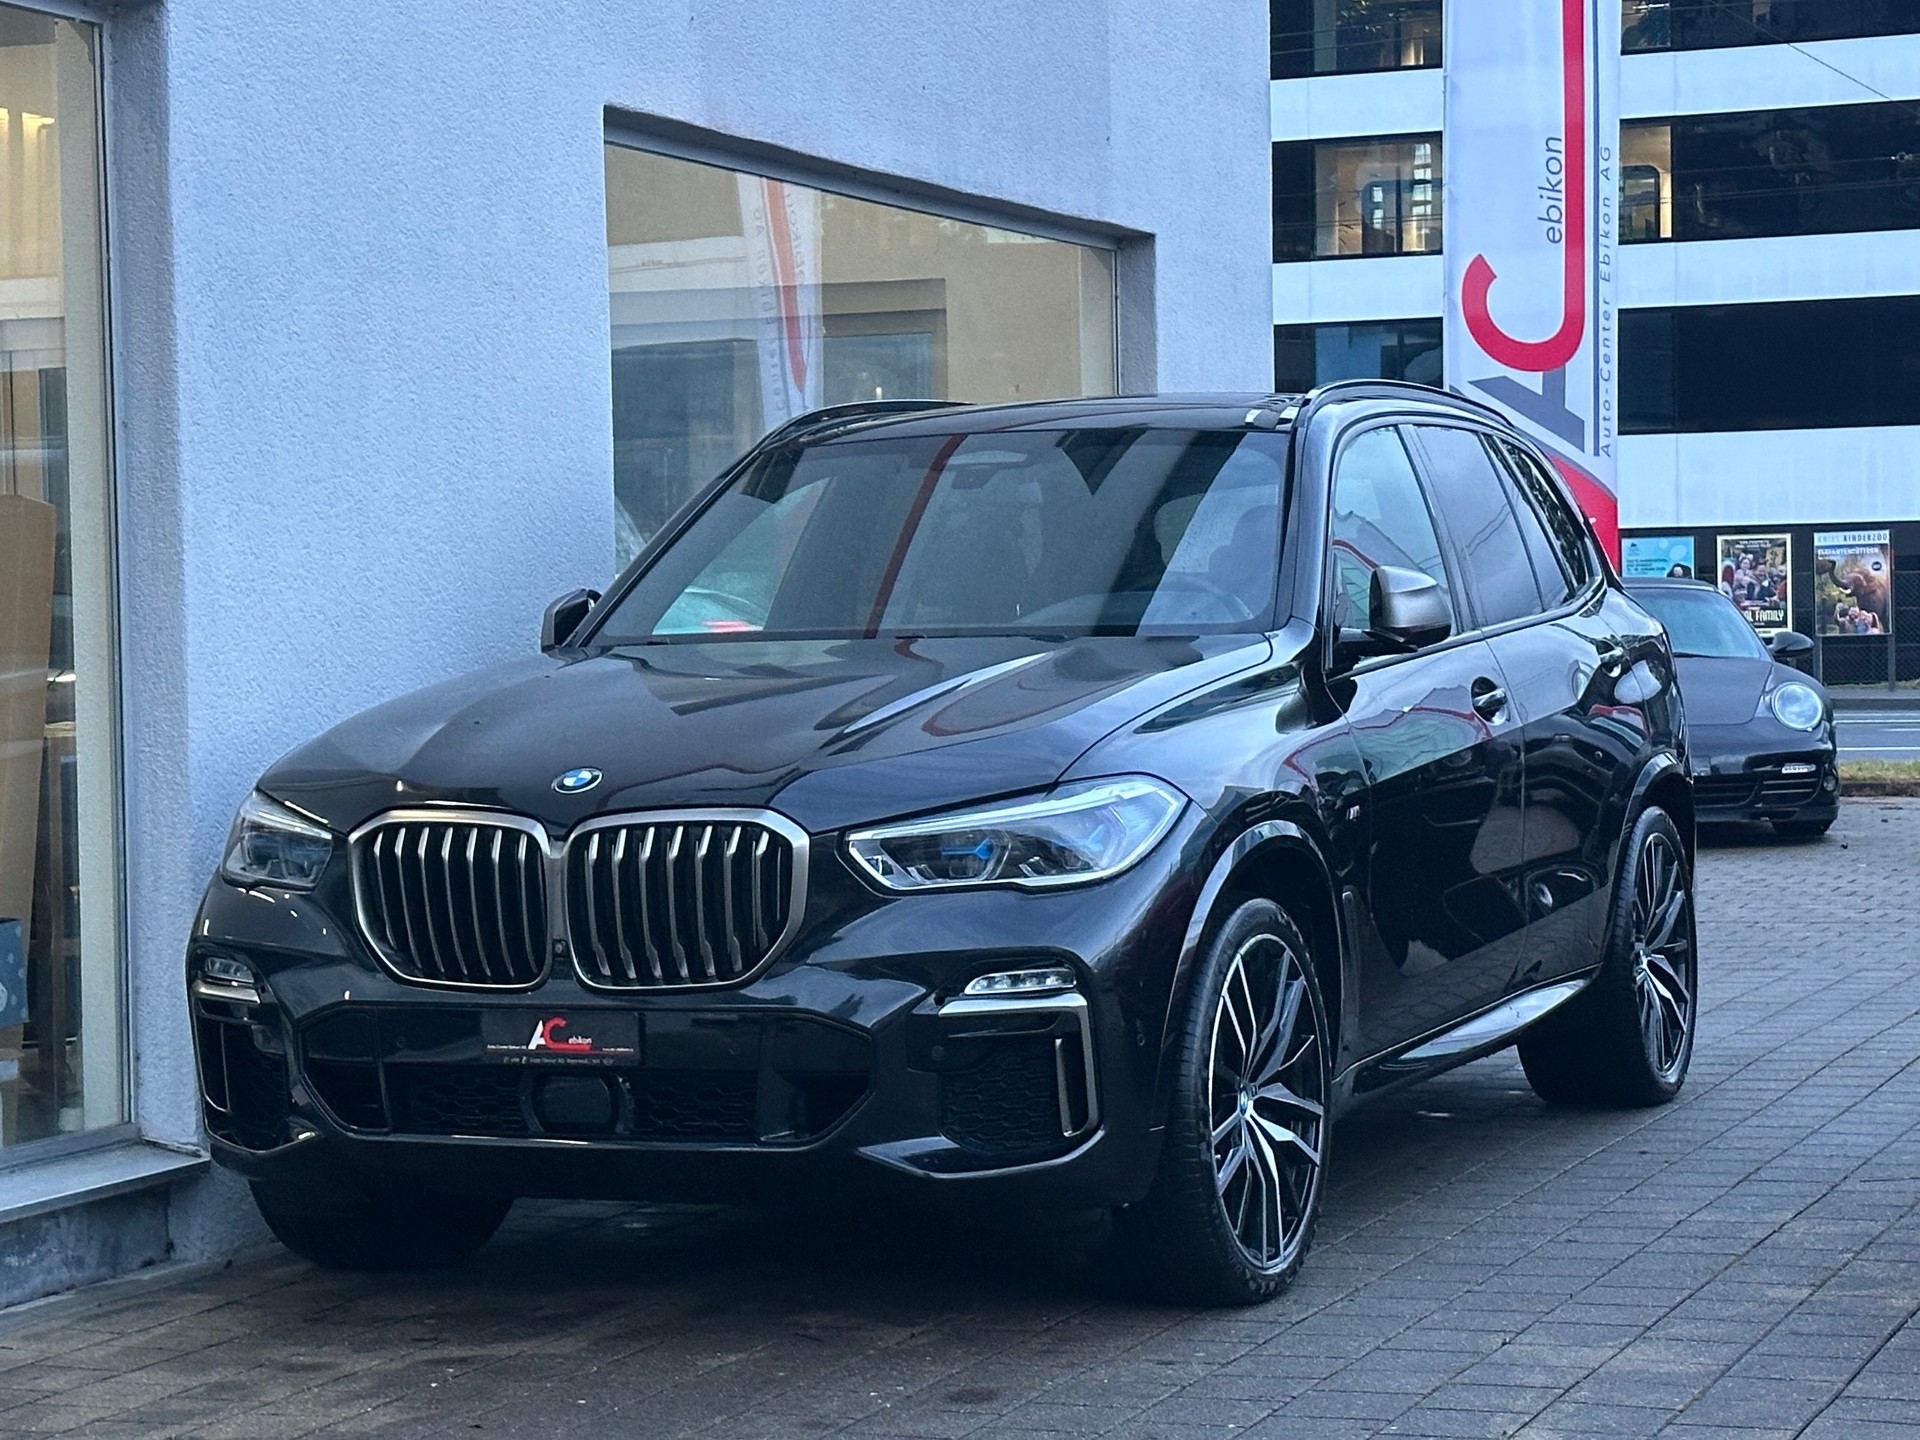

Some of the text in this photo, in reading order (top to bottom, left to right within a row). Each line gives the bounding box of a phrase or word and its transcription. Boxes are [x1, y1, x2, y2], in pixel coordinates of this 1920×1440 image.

[1537, 136, 1563, 245] ebikon
[1600, 146, 1611, 458] Auto-Center Ebikon AG
[1843, 532, 1888, 542] KINDERZOO
